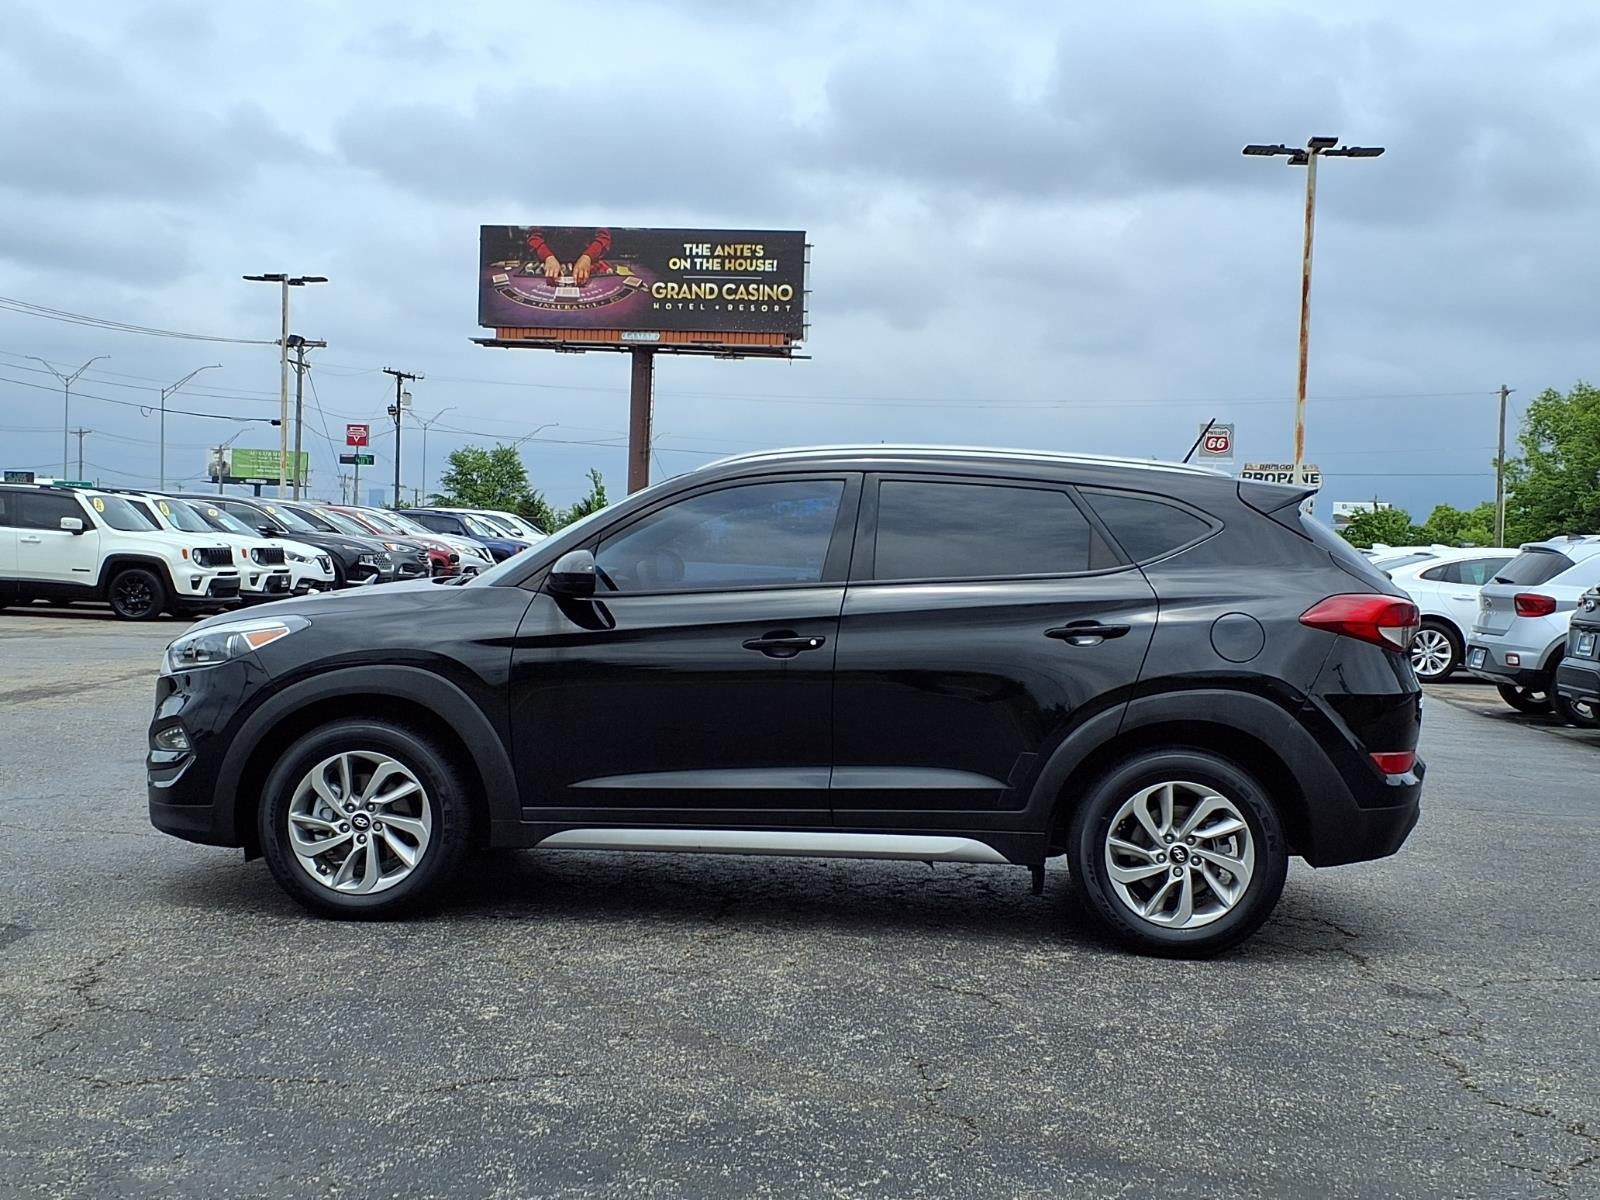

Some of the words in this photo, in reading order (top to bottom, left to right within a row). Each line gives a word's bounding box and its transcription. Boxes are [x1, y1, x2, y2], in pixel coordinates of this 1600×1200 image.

[683, 243, 711, 256] THE
[714, 244, 764, 257] ANTE'S
[668, 257, 691, 270] ON
[694, 258, 721, 271] THE
[724, 259, 777, 272] HOUSE!
[651, 281, 719, 300] GRAND
[722, 283, 793, 302] CASINO
[653, 302, 705, 311] HOTEL
[727, 303, 791, 312] RESORT
[1207, 437, 1226, 449] 66
